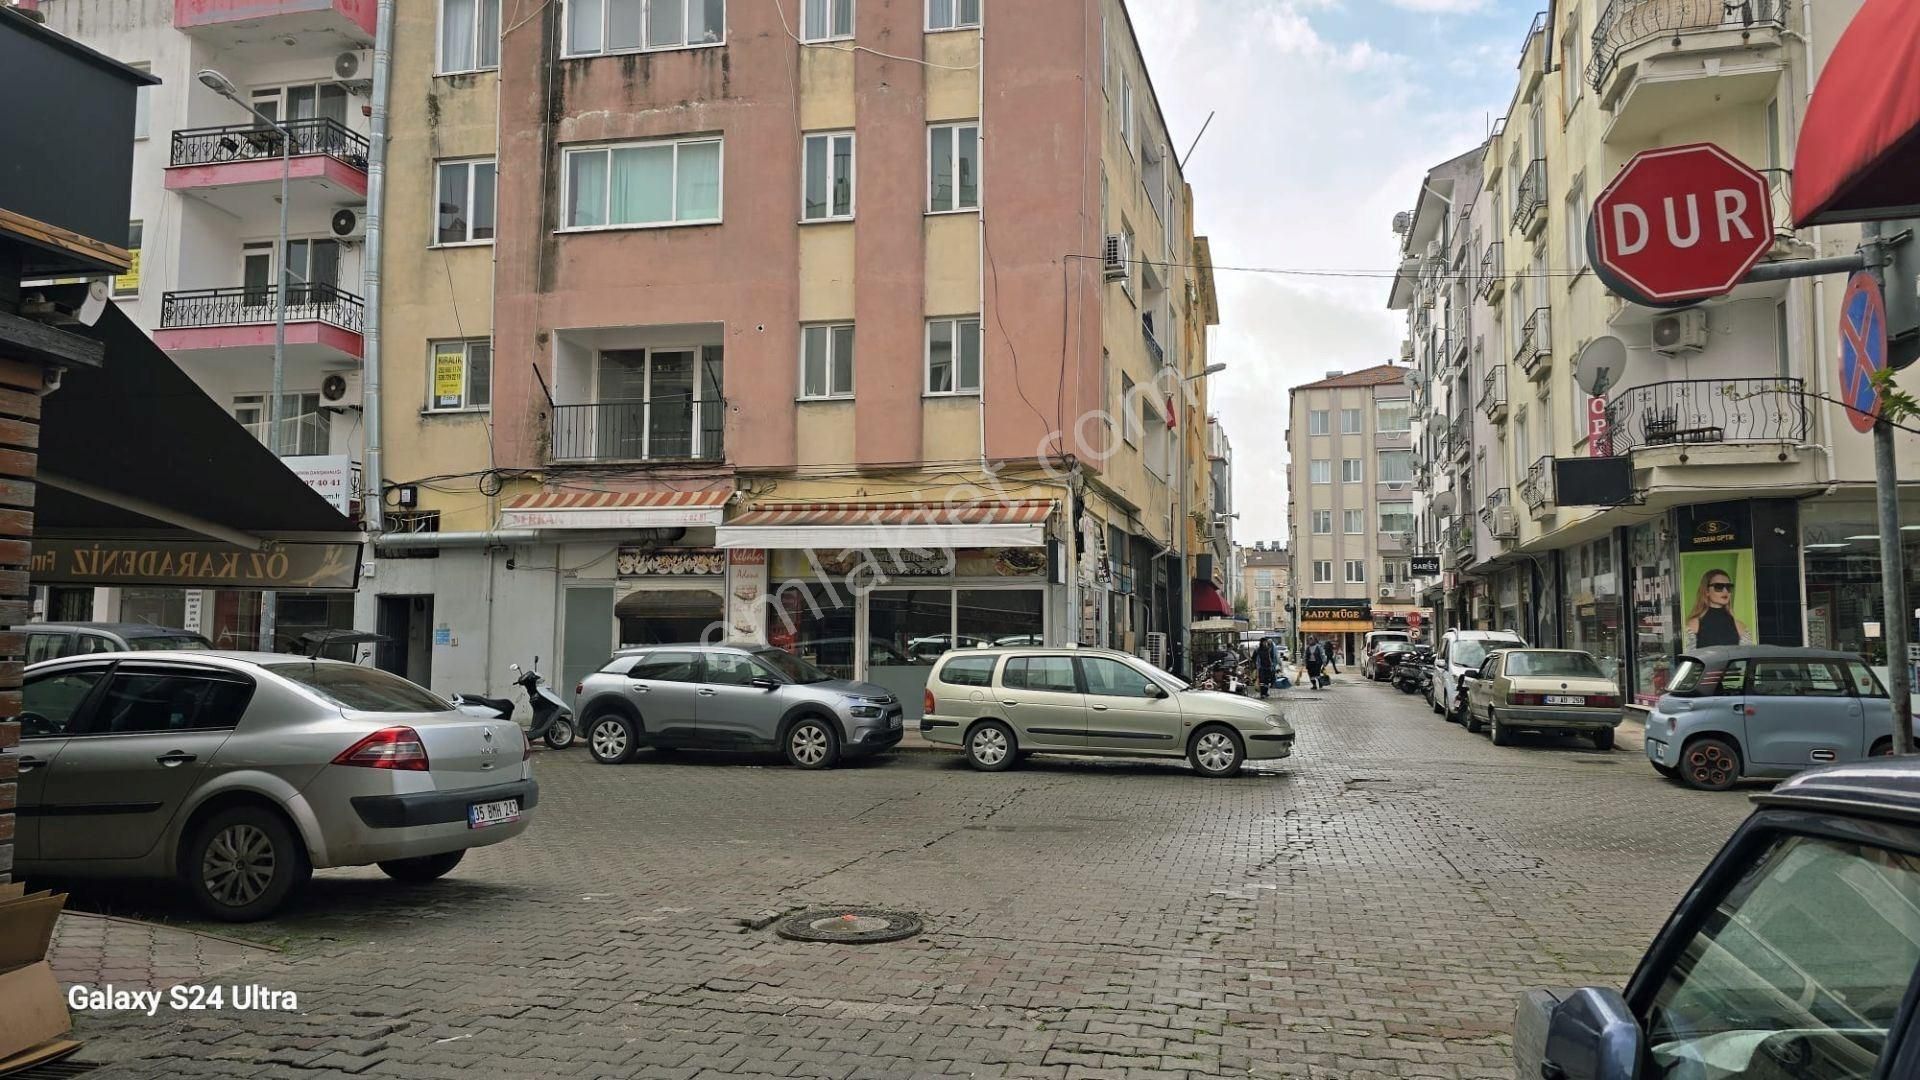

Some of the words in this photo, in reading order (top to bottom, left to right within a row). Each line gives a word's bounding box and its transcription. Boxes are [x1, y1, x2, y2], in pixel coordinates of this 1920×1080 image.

[1613, 188, 1754, 256] DUR
[1305, 610, 1330, 619] LADY
[1332, 609, 1360, 619] MÜGE
[474, 807, 485, 820] 35
[488, 803, 502, 818] BMH
[504, 801, 518, 816] 243
